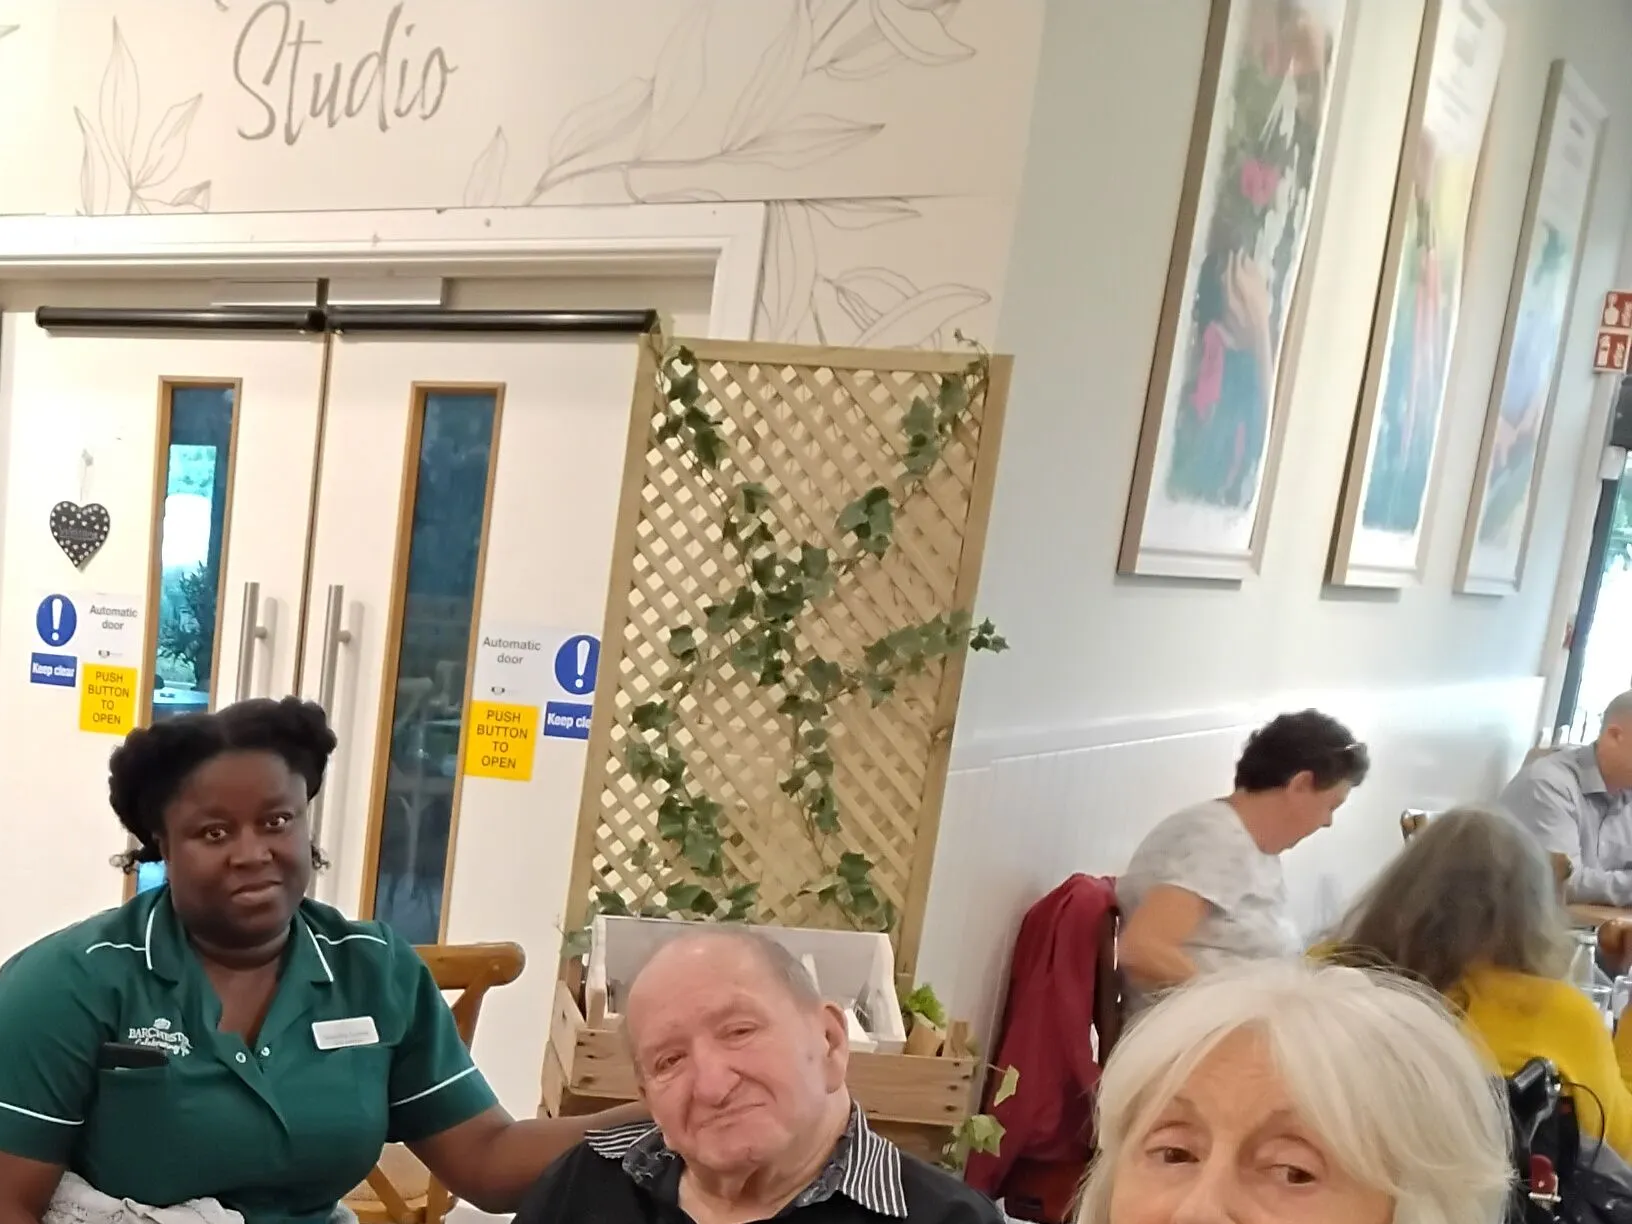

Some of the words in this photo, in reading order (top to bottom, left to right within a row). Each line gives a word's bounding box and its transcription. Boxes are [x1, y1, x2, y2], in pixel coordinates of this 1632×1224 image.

[233, 0, 458, 146] Studio
[90, 605, 138, 618] Automatic
[102, 620, 124, 630] door
[483, 636, 541, 652] Automatic
[497, 653, 523, 665] door
[32, 663, 52, 676] Keep
[54, 666, 75, 677] clear
[95, 671, 124, 683] PUSH
[88, 685, 129, 698] BUTTON
[101, 699, 114, 711] TO
[92, 713, 121, 725] OPEN
[486, 709, 521, 723] PUSH
[547, 713, 573, 729] Keep
[575, 716, 592, 728] cle
[476, 724, 528, 740] BUTTON
[492, 741, 508, 753] TO
[481, 755, 516, 769] OPEN
